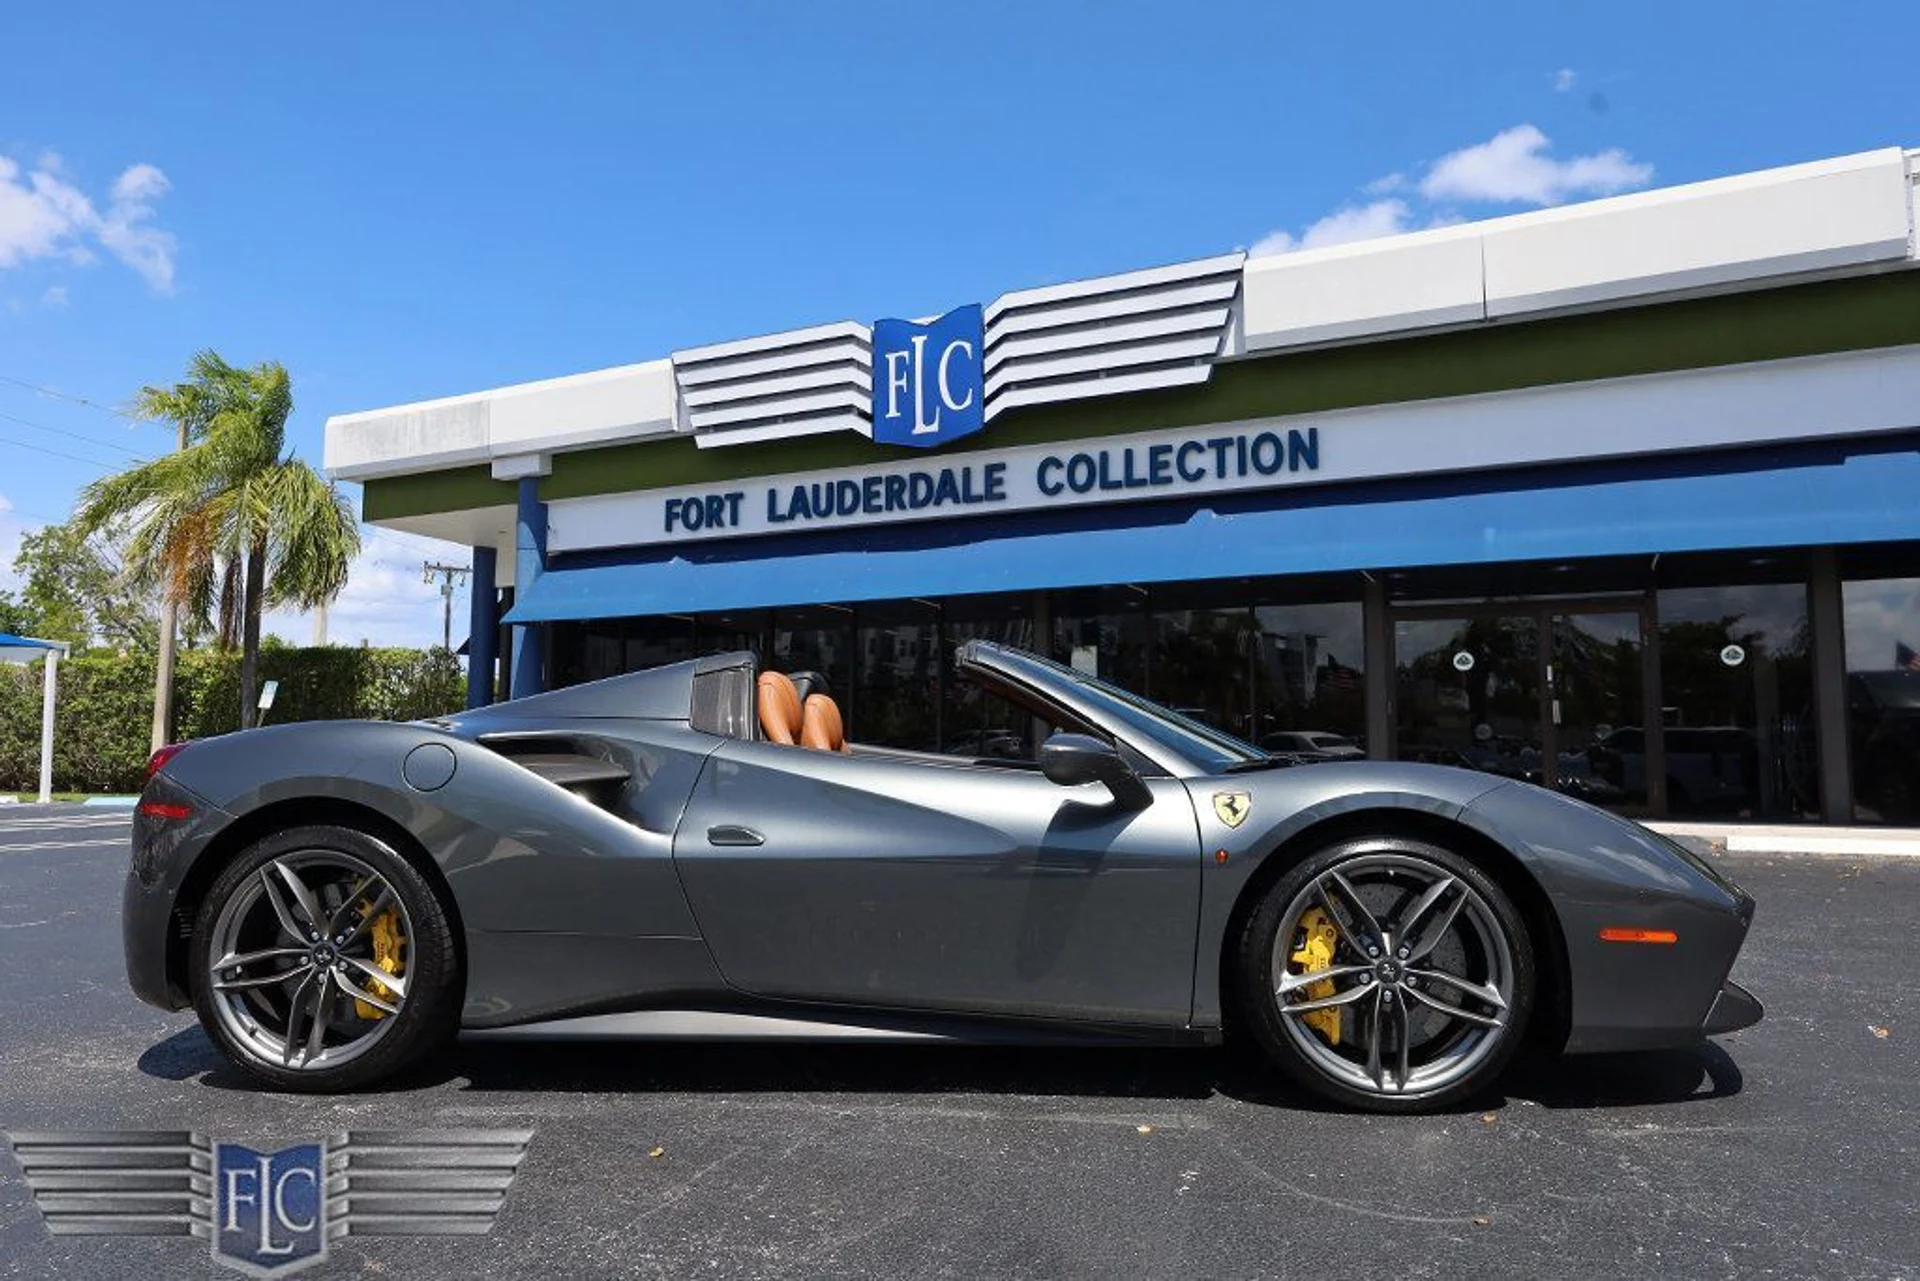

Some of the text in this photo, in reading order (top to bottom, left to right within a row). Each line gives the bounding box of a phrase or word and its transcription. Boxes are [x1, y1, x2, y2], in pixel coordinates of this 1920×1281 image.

[884, 334, 973, 433] FLC
[664, 427, 1319, 533] FORT LAUDERDALE COLLECTION
